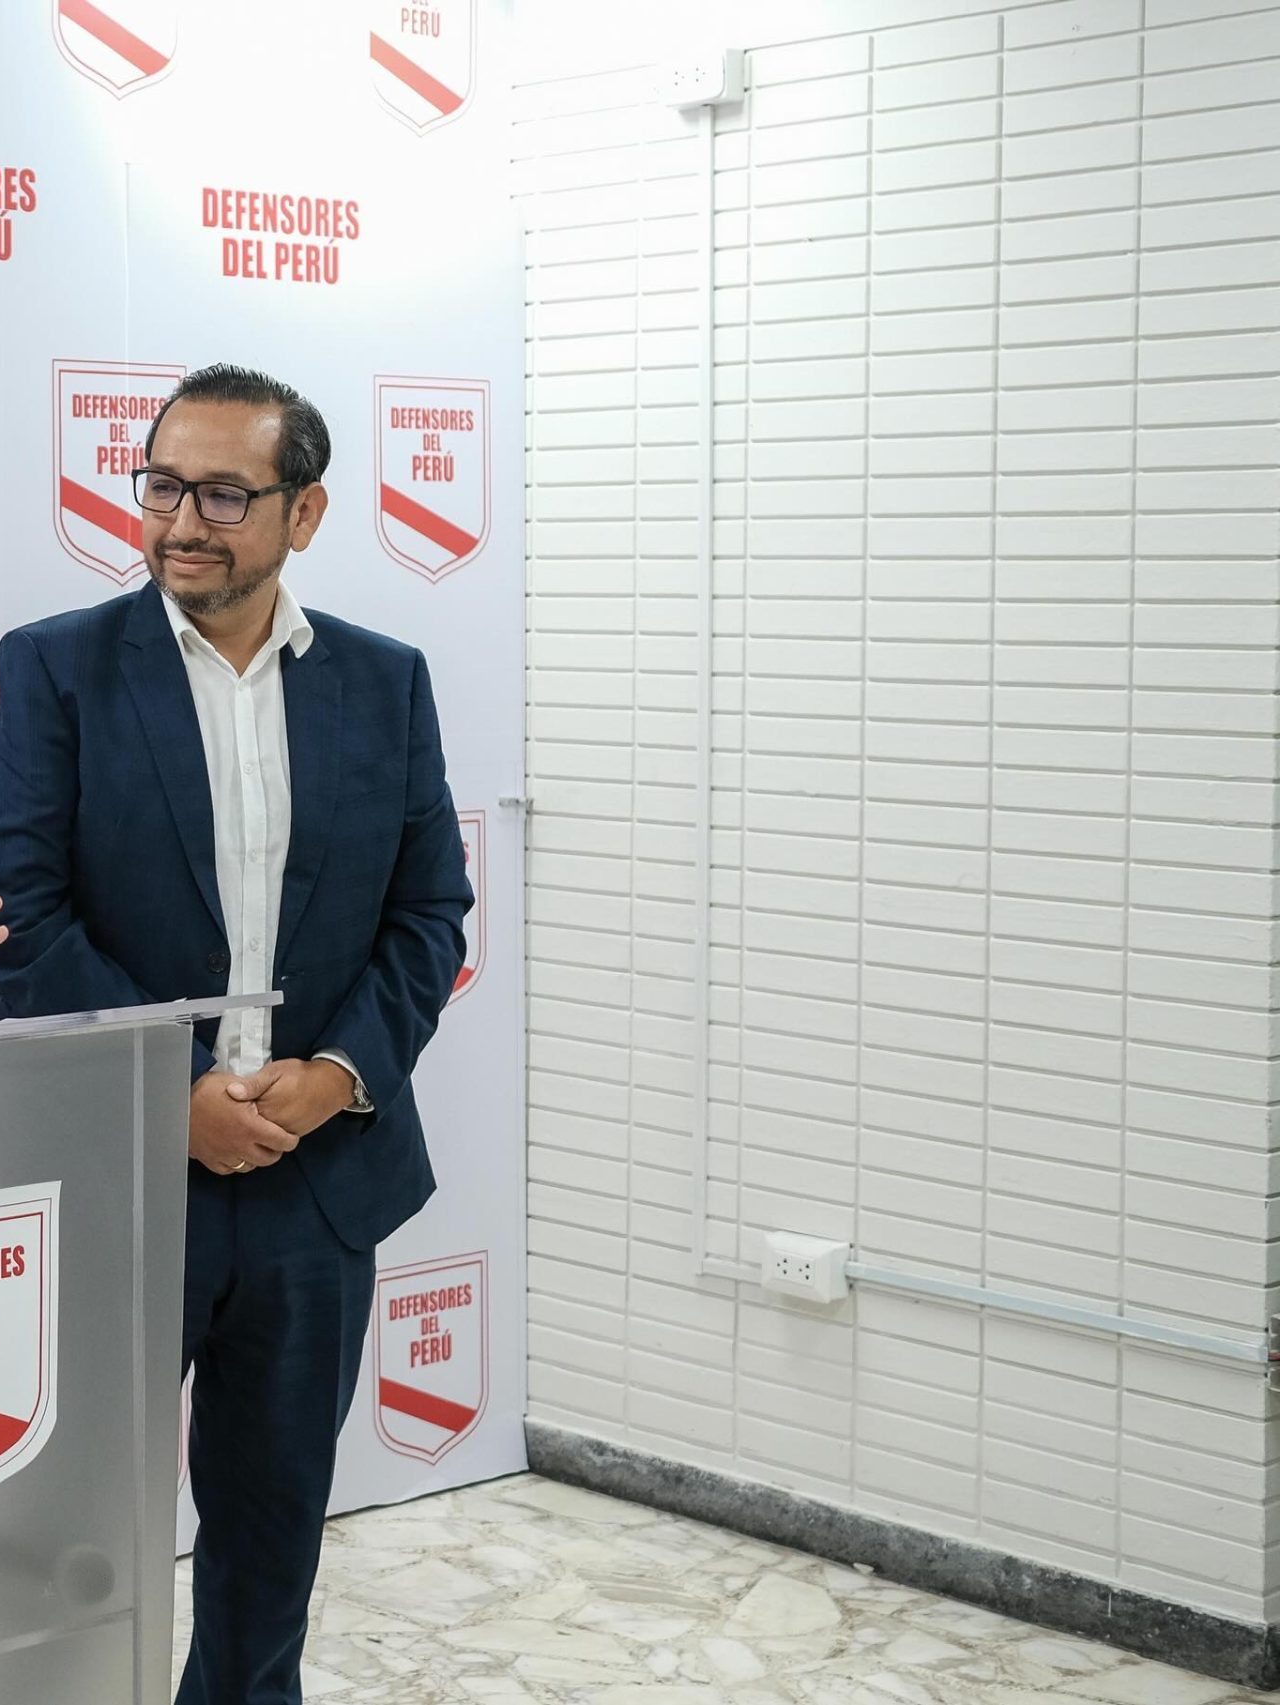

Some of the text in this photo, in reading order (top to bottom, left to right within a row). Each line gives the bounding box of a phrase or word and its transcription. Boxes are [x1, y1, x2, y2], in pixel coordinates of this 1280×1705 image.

[202, 187, 359, 240] DEFENSORES
[223, 237, 339, 284] DEL PERÚ
[109, 422, 129, 443] DEL
[391, 407, 474, 432] DEFENSORES
[423, 432, 439, 453] DEL
[412, 450, 454, 482] PERÚ
[389, 1284, 471, 1319] DEFENSORES
[421, 1315, 438, 1336] DEL
[410, 1330, 451, 1367] PERÚ
